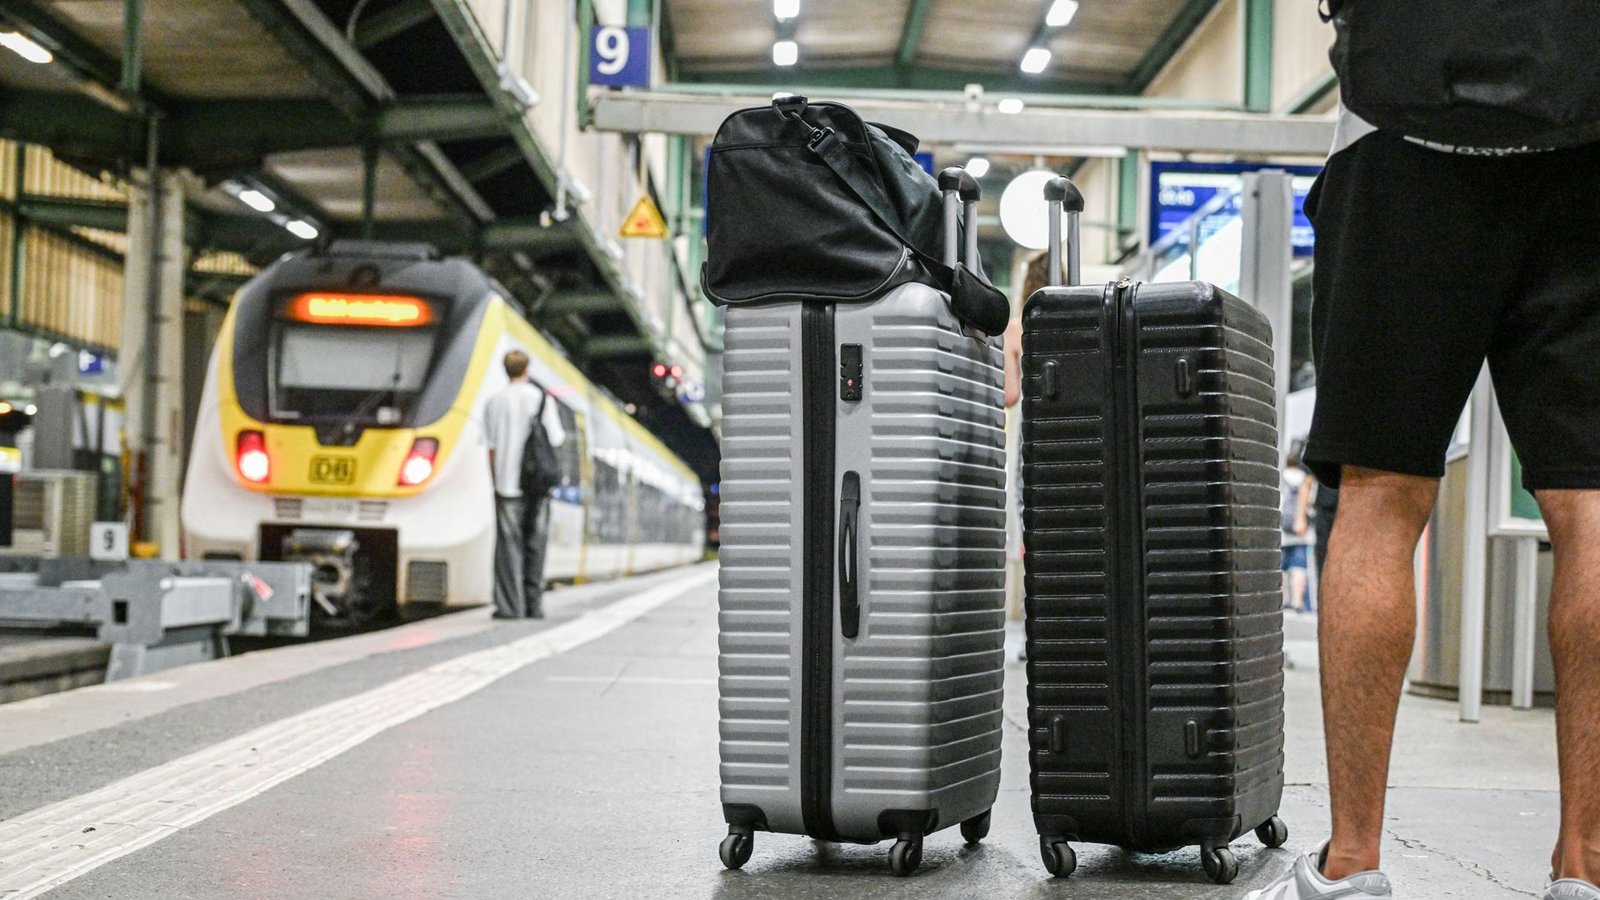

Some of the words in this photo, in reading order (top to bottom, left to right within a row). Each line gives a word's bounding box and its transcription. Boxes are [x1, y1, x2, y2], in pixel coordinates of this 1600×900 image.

[596, 27, 629, 75] 9
[103, 528, 114, 551] 9
[1557, 884, 1585, 896] NIKE
